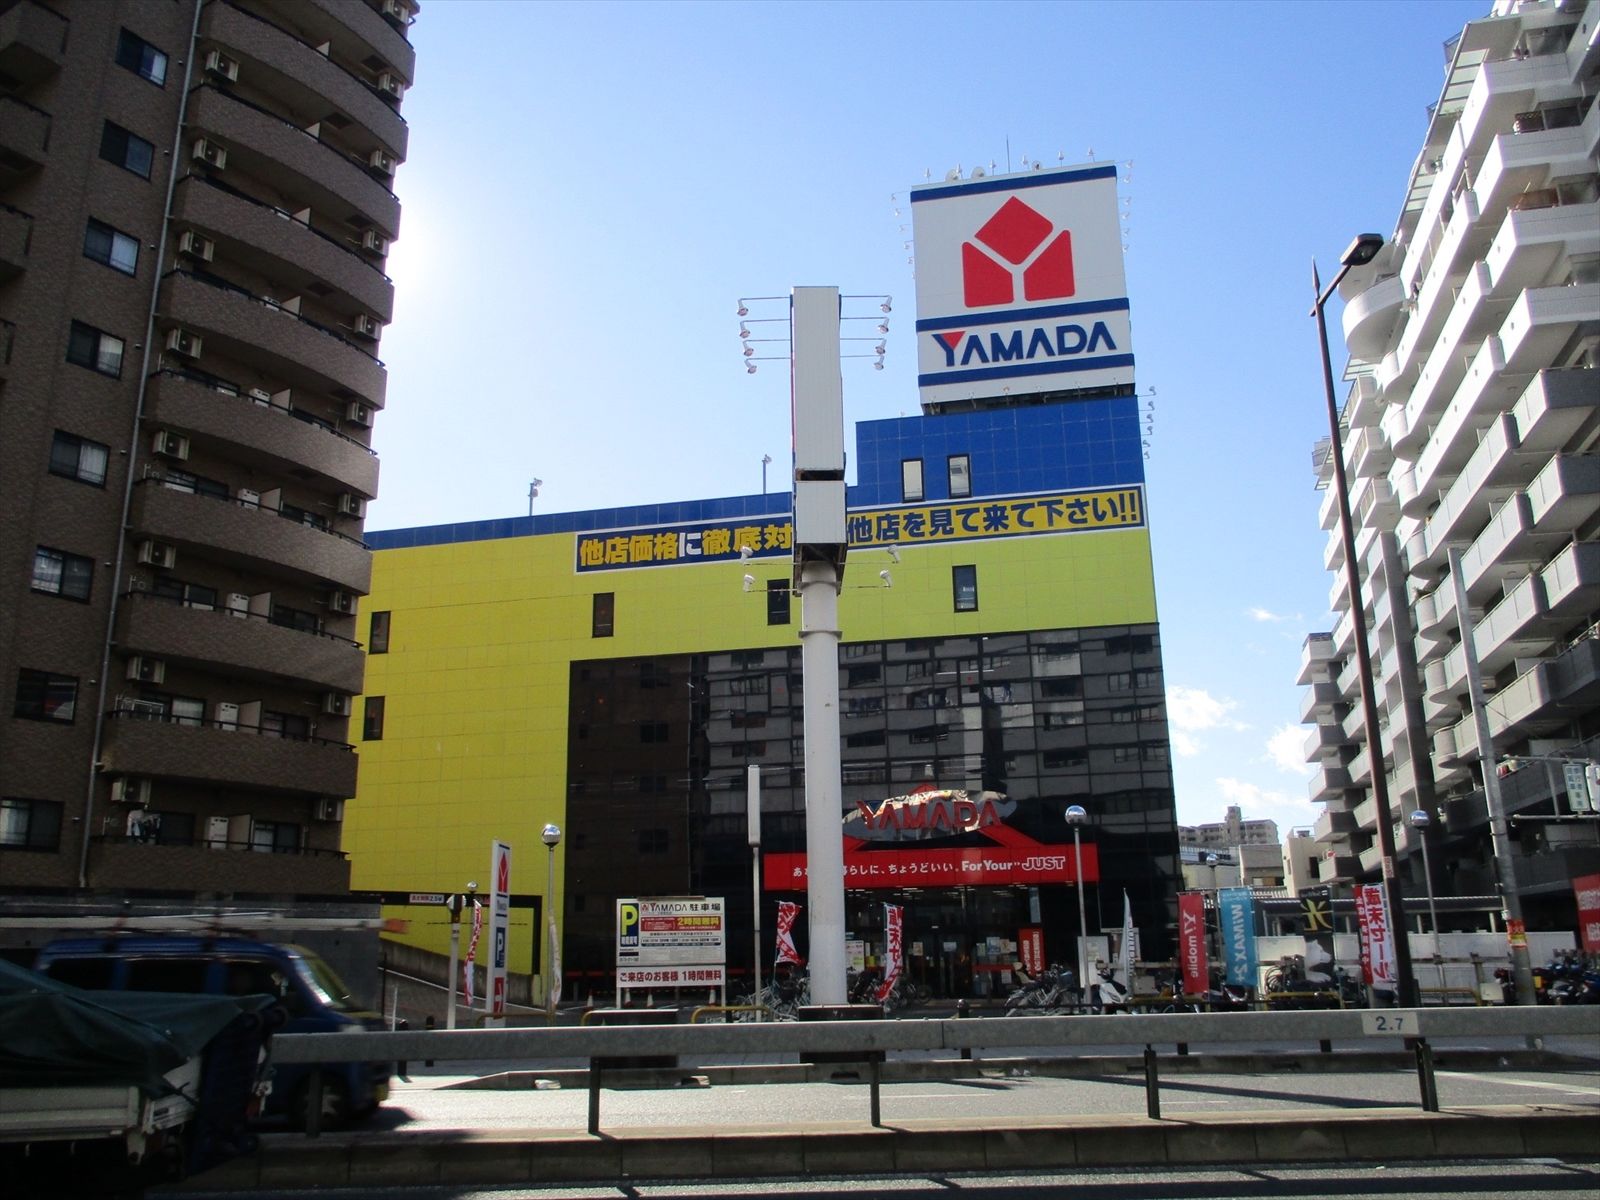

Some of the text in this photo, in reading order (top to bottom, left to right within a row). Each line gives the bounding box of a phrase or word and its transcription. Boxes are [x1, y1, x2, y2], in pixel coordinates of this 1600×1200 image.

[931, 321, 1117, 367] YAMADA
[856, 800, 1002, 831] YAMADA
[962, 861, 982, 871] For
[650, 903, 687, 911] YAMADA
[621, 905, 638, 935] P
[1376, 1016, 1403, 1031] 2.7
